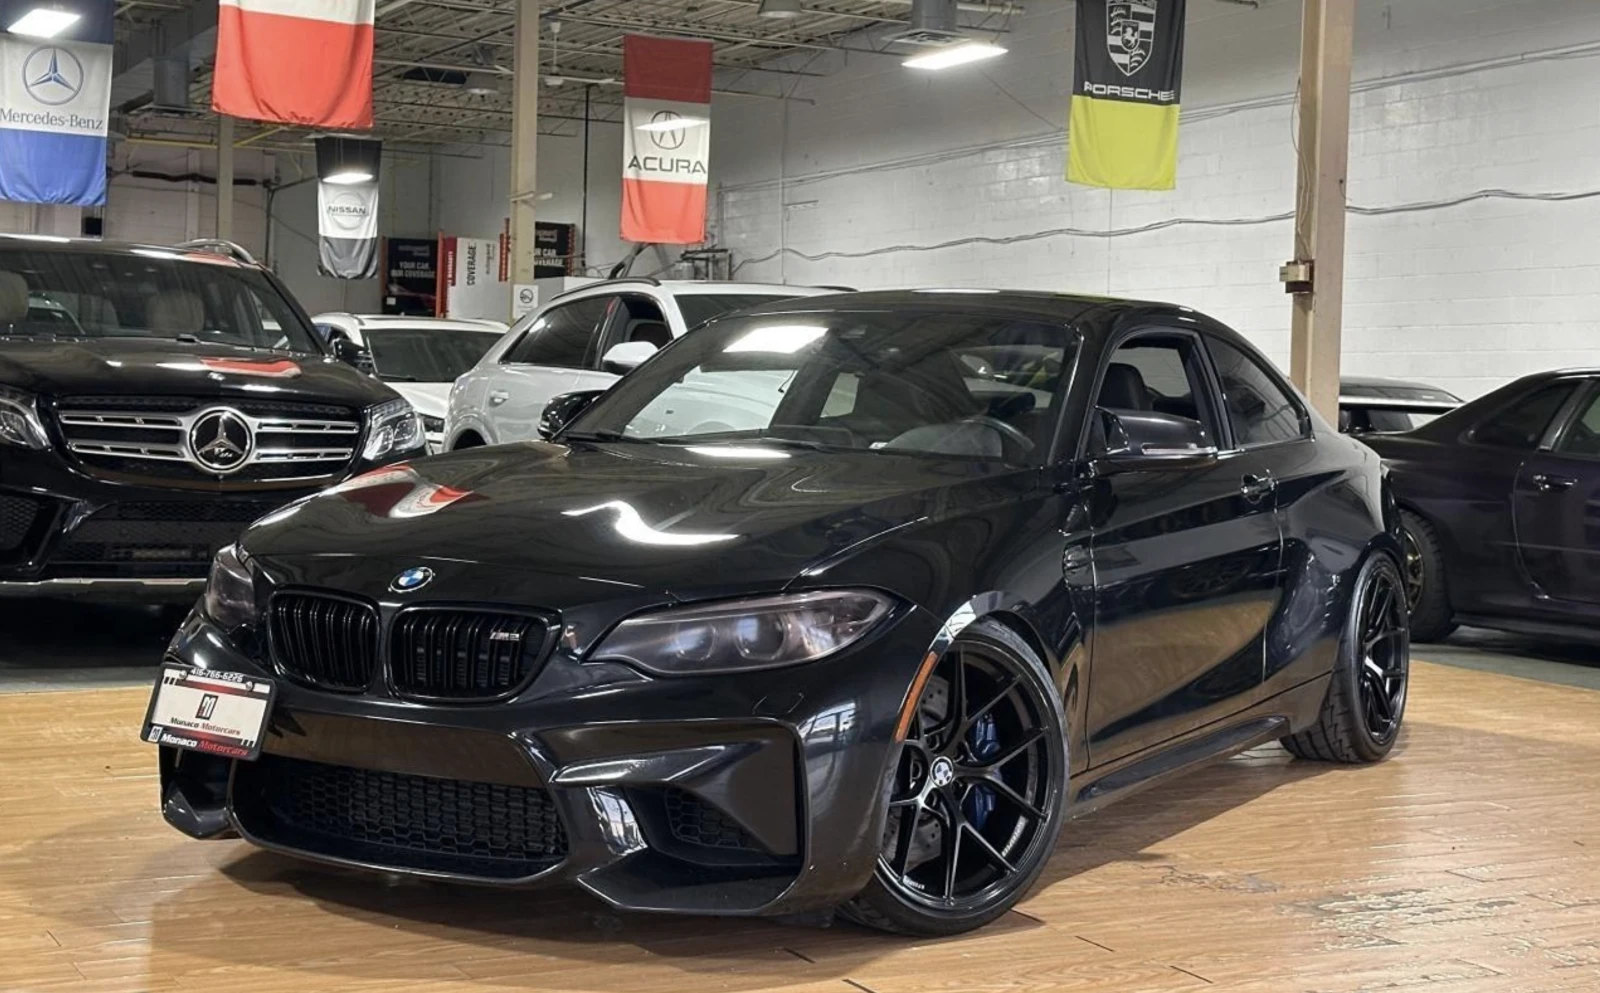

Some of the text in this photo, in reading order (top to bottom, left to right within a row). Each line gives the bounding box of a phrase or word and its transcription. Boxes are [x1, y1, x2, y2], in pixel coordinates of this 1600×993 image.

[1083, 80, 1175, 101] PORSCHE
[0, 107, 103, 130] Mercedes-Benz
[627, 155, 707, 174] ACURA
[328, 205, 366, 215] NISSAN
[170, 717, 241, 736] Monaco Motorcars
[161, 733, 198, 748] Monaco
[198, 740, 249, 757] Motorcars
